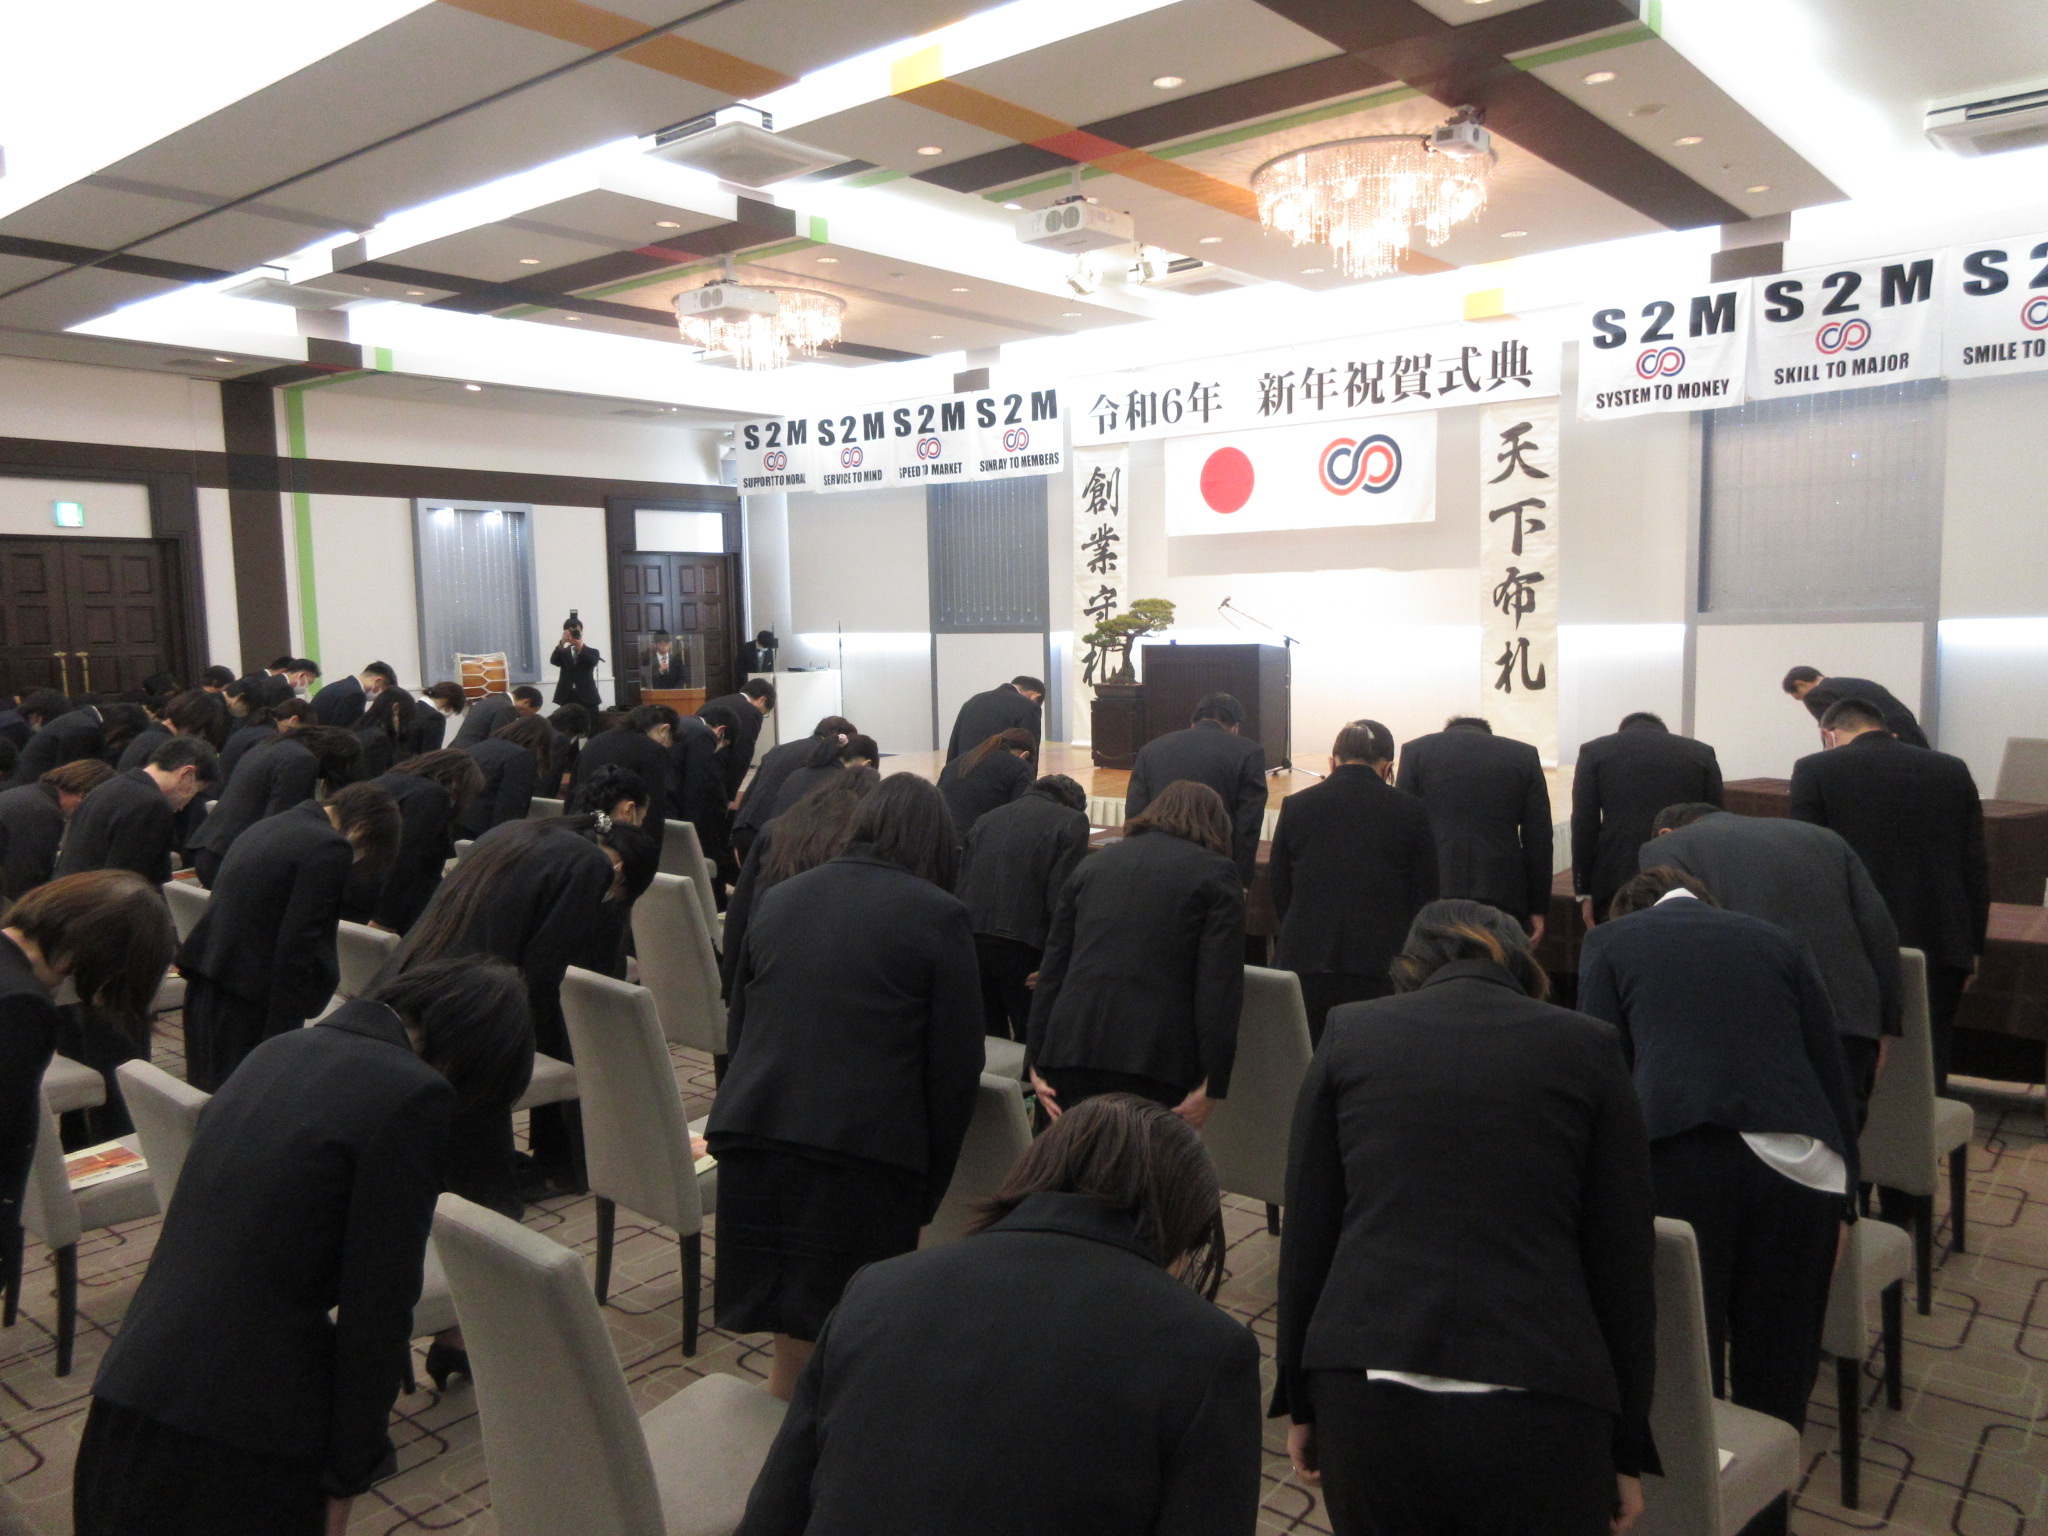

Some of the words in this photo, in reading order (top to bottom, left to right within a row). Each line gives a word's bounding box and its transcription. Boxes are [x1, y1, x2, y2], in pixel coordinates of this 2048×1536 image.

[1764, 258, 1933, 323] S2M
[1592, 291, 1738, 349] S2M
[1774, 367, 1820, 385] SKILL
[1826, 360, 1847, 379] TO
[1852, 351, 1910, 374] MAJOR
[1962, 341, 2017, 365] SMILE
[2021, 338, 2046, 358] TO
[1089, 381, 1222, 435] 令和6年
[1256, 339, 1534, 418] 新年祝賀式典
[1596, 388, 1651, 409] SYSTEM
[1654, 383, 1673, 401] TO
[1677, 378, 1730, 400] MONEY
[893, 400, 966, 437] S2M
[975, 388, 1059, 430] S2M
[743, 418, 808, 451] S2M
[817, 411, 886, 447] S2M
[823, 472, 851, 486] SERVICE
[853, 471, 863, 483] TO
[863, 469, 883, 482] MIND
[899, 466, 921, 479] SPEED
[931, 462, 963, 475] MARKET
[979, 457, 1008, 473] SUNRAY
[1009, 455, 1020, 469] TO
[1020, 452, 1060, 468] MEMBERS
[743, 476, 774, 489] SUPPORT
[775, 475, 785, 486] TO
